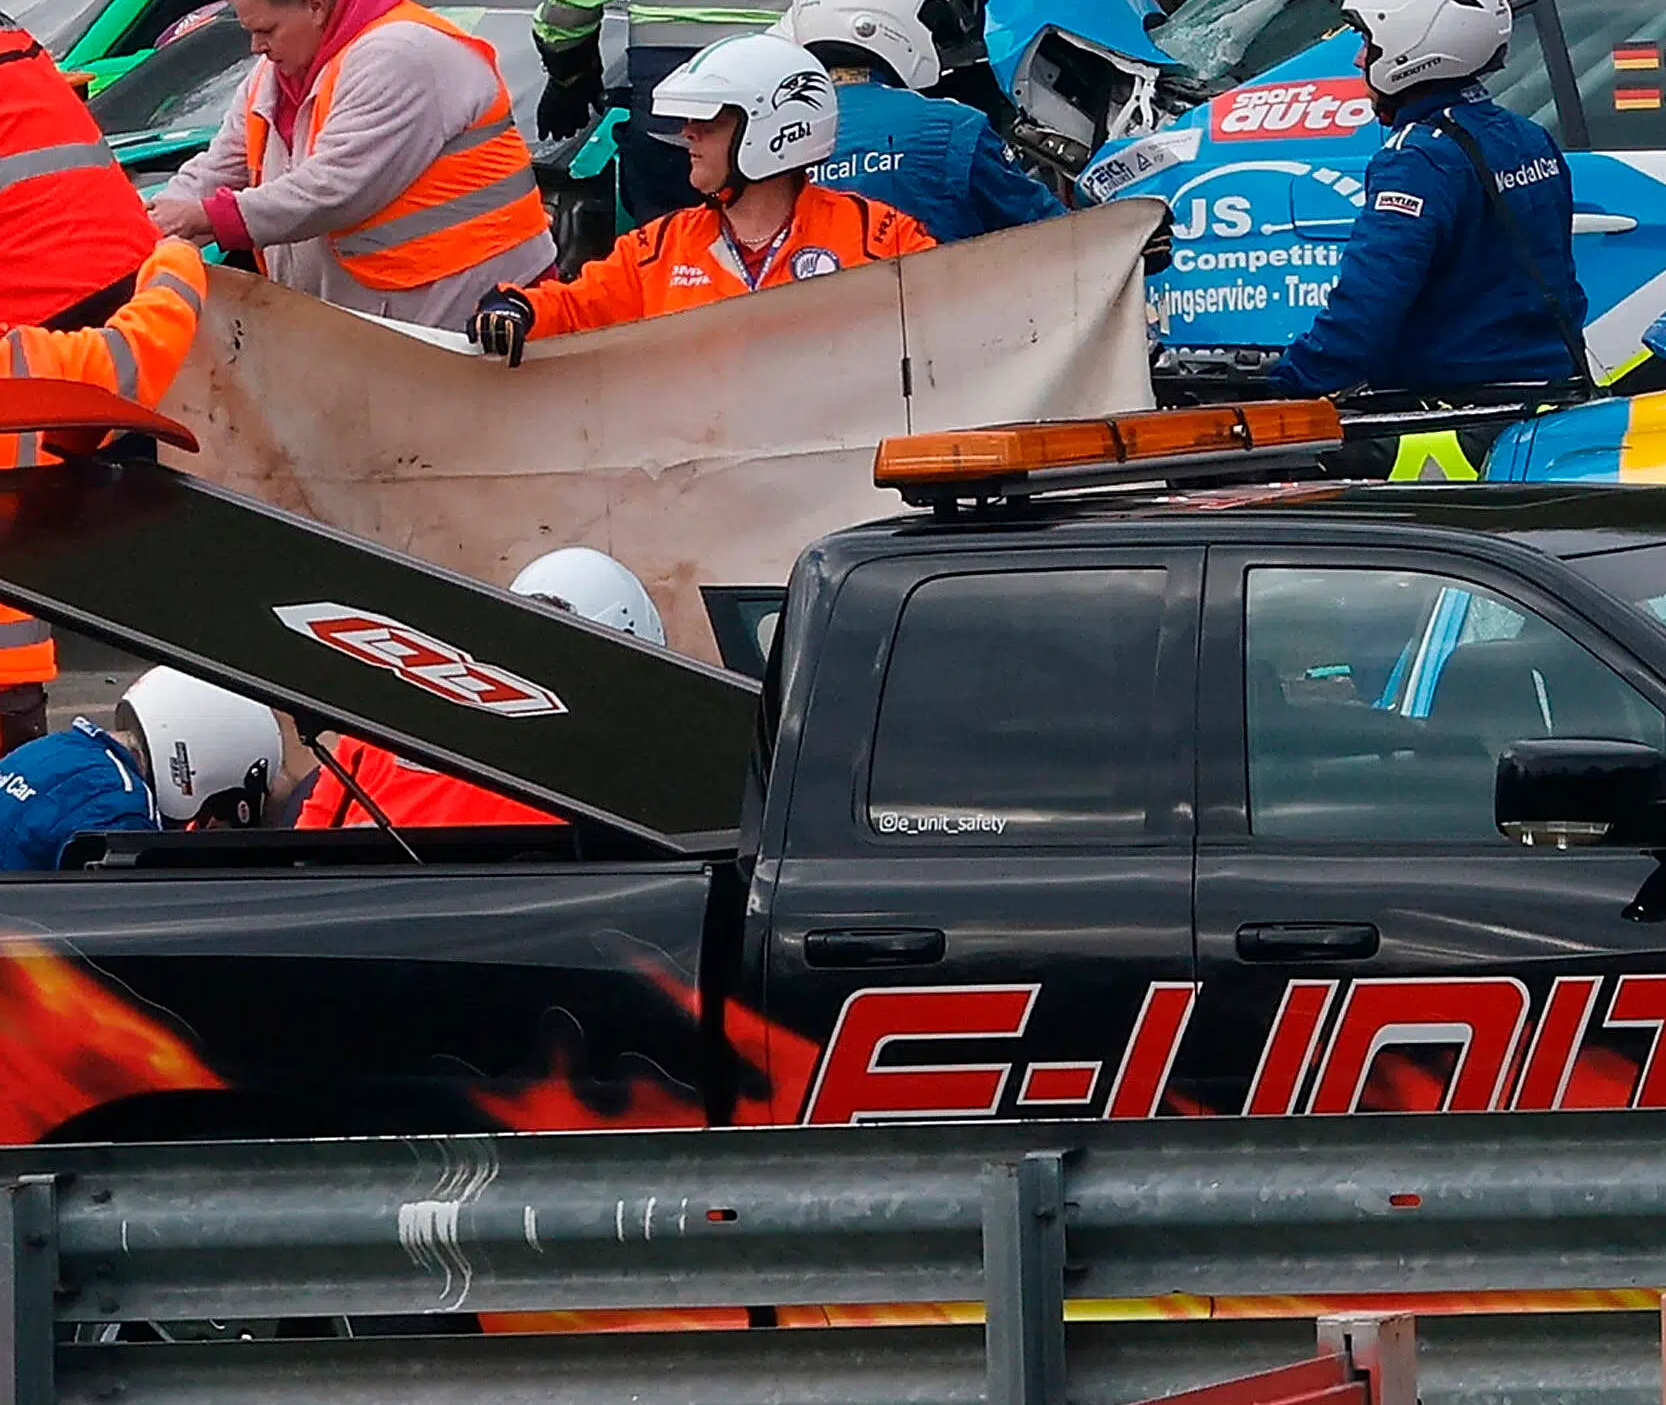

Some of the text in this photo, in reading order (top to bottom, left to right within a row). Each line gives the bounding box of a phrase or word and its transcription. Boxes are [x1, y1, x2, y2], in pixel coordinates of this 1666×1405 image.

[1236, 84, 1316, 111] sport
[1220, 96, 1375, 133] auto
[864, 152, 905, 172] Car
[1170, 196, 1253, 240] JS
[1173, 244, 1343, 273] Competiti
[899, 813, 1007, 834] e_unit_safety
